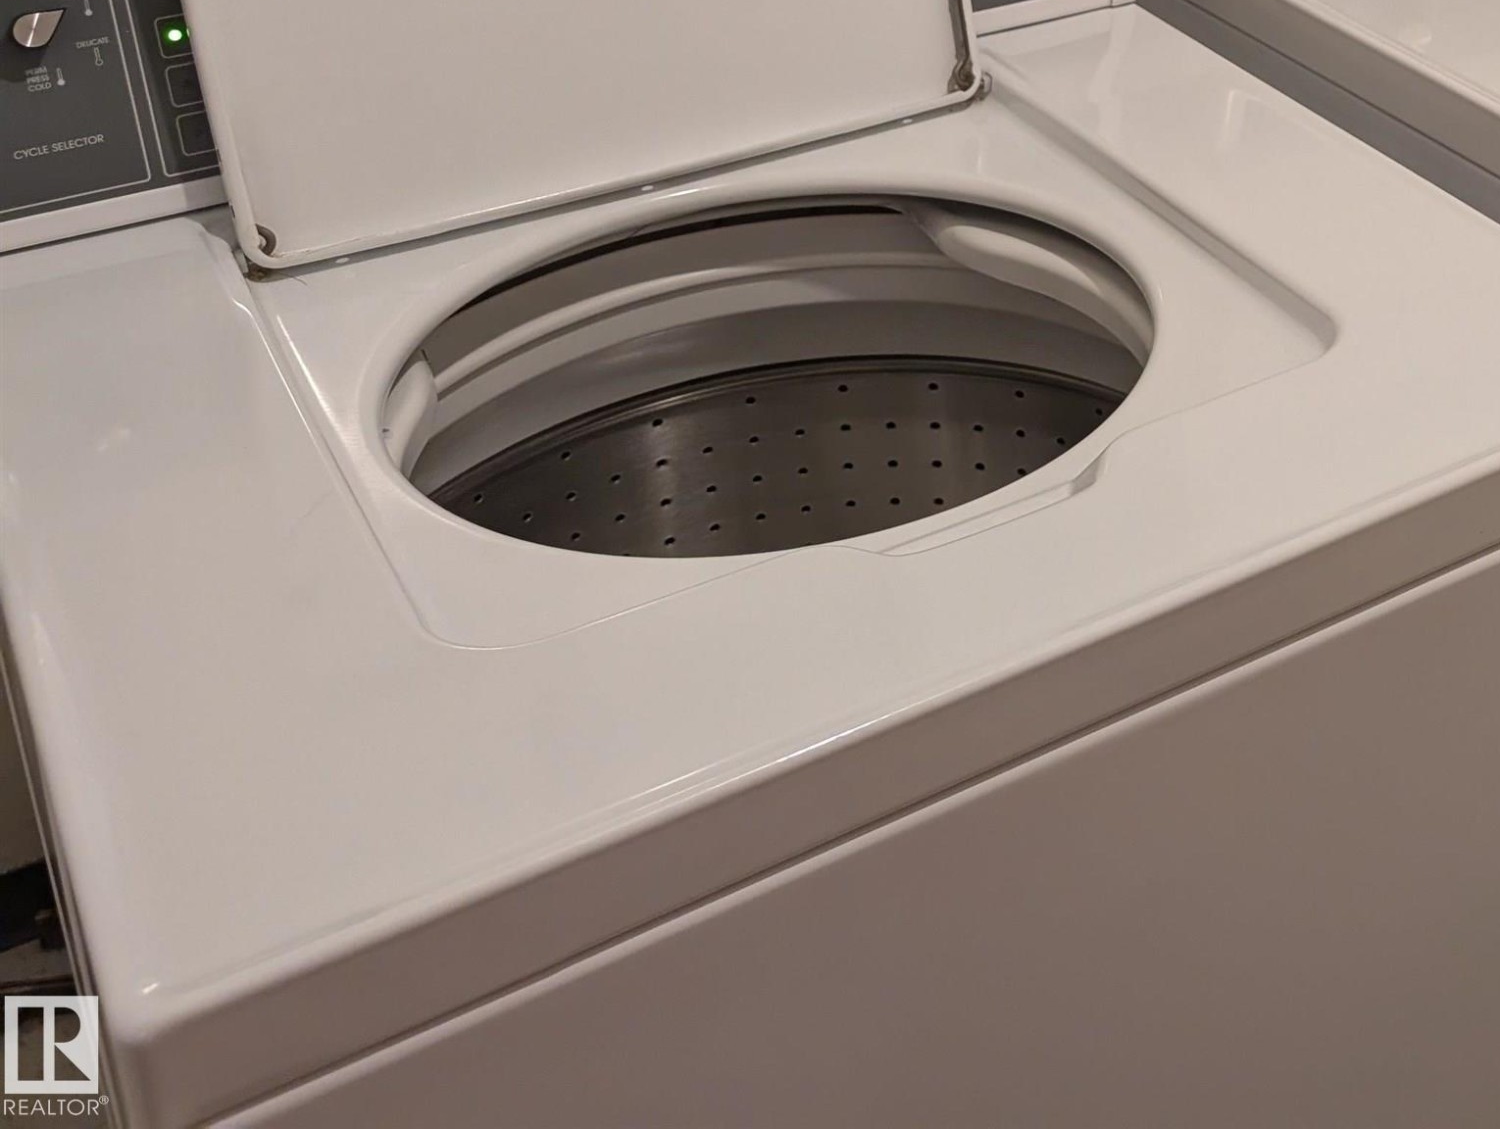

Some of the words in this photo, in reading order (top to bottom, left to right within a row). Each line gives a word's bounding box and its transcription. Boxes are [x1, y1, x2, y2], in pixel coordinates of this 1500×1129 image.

[76, 36, 110, 49] DELICATE
[28, 81, 52, 92] COLD
[13, 145, 50, 160] CYCLE
[51, 133, 105, 153] SELECTOR
